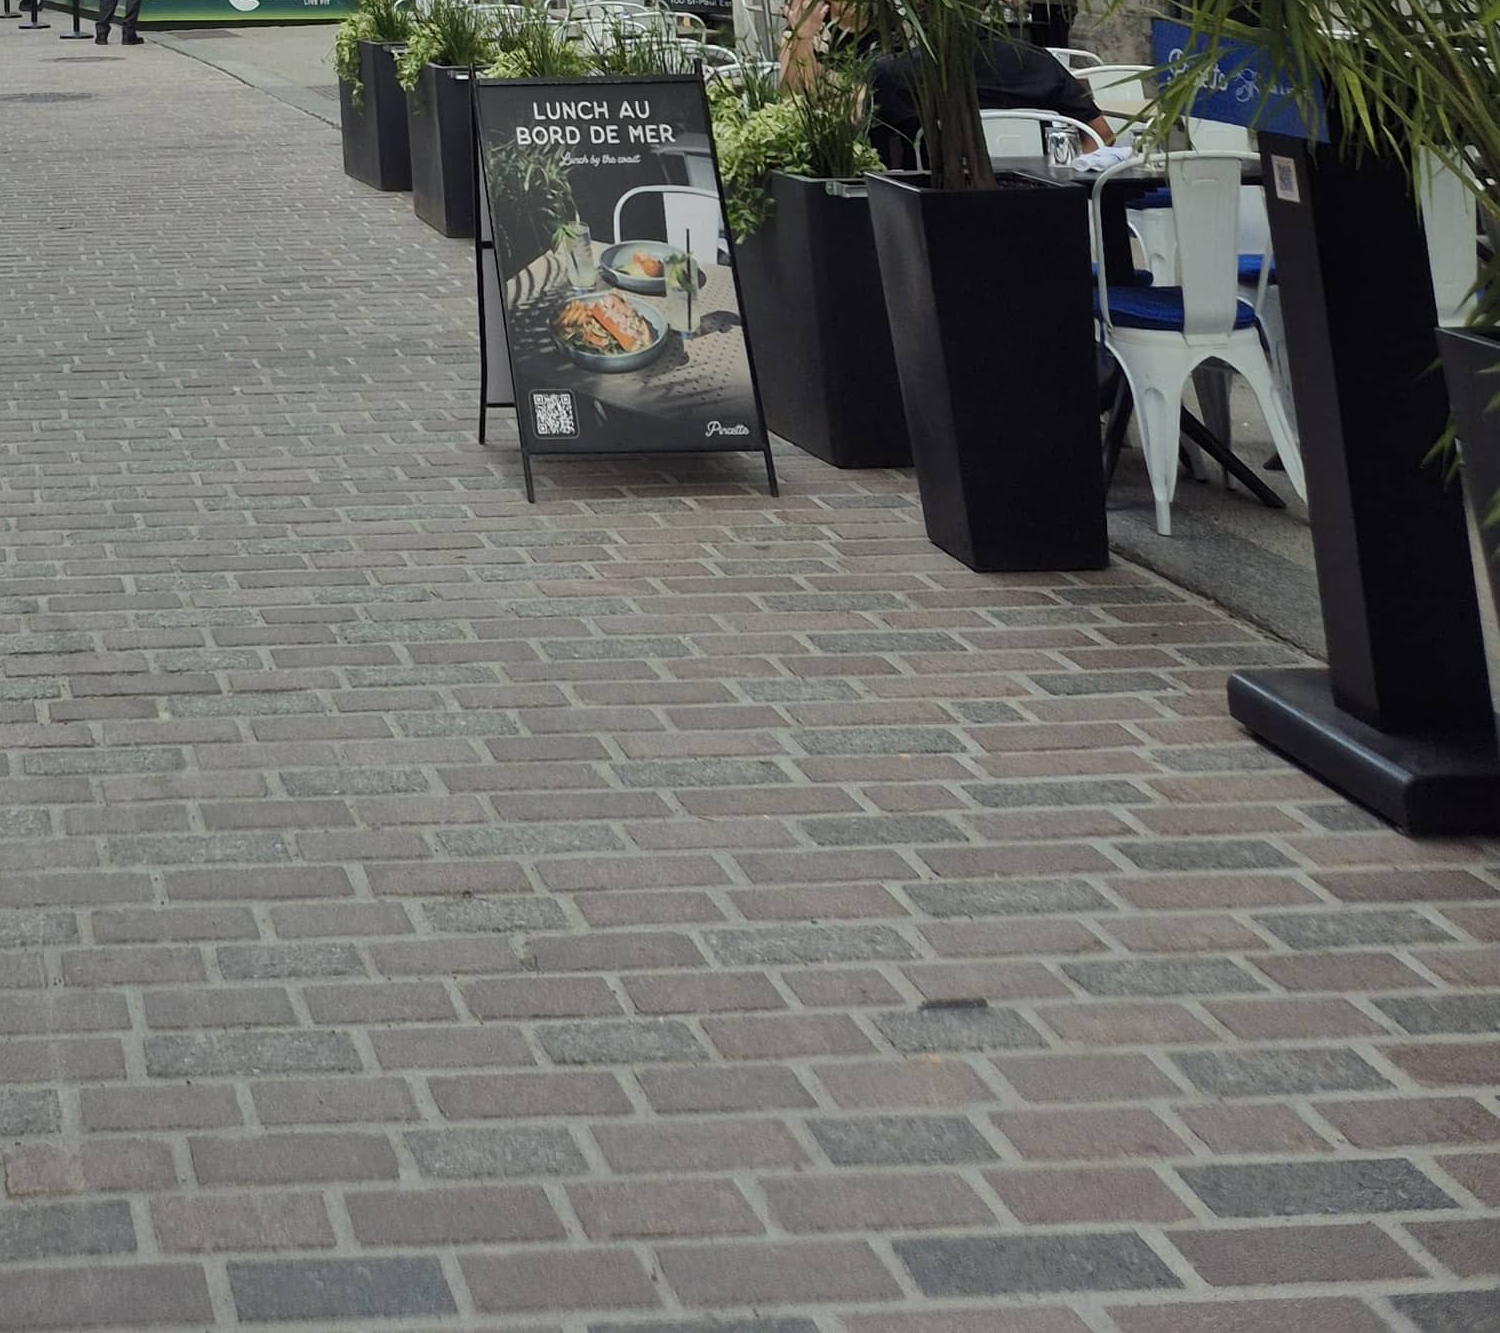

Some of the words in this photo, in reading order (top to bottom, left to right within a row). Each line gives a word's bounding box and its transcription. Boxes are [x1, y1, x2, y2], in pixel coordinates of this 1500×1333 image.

[533, 100, 610, 120] LUNCH
[618, 99, 650, 119] AU
[516, 125, 581, 145] BORD
[590, 124, 621, 144] DE
[628, 123, 677, 144] MER
